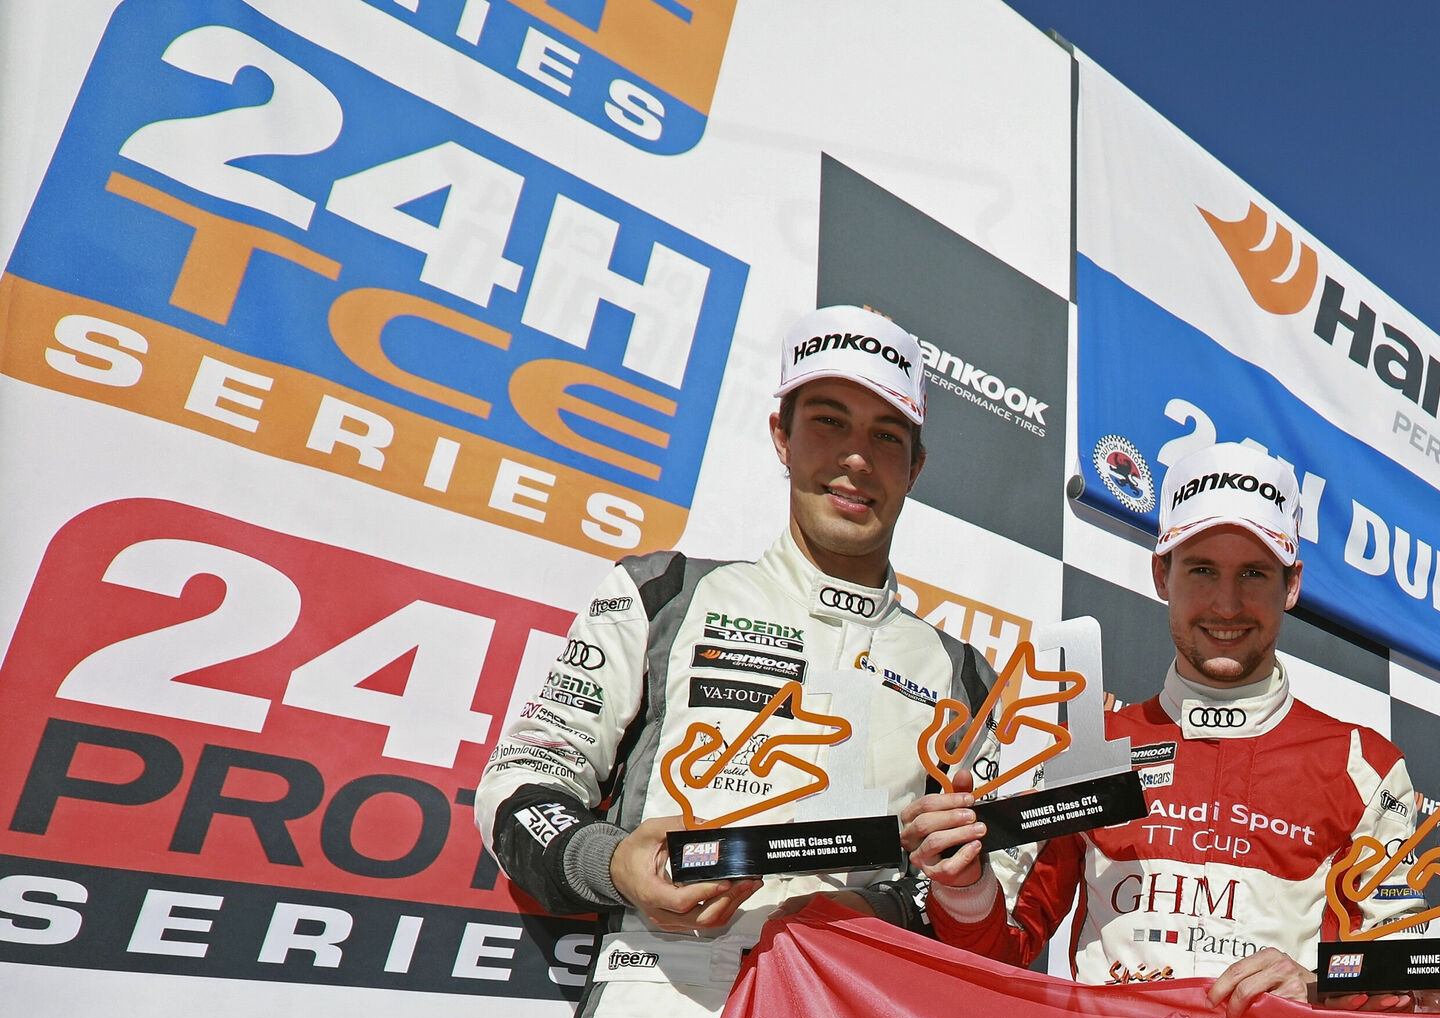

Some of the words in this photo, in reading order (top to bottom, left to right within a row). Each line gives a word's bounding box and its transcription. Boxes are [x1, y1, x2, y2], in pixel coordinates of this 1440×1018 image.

[118, 25, 711, 390] 24H
[105, 171, 678, 482] TCE
[44, 314, 645, 550] SERIES
[1014, 417, 1046, 438] TIRES
[1157, 398, 1326, 545] 2H
[732, 660, 762, 670] driving
[763, 665, 799, 677] emotion
[545, 671, 604, 701] HOENIX
[700, 684, 784, 708] 'VA-TOUT
[883, 669, 938, 700] DUBAI
[8, 717, 510, 891] PROT
[1020, 804, 1056, 820] WINNER
[1056, 800, 1080, 812] Class
[1081, 795, 1098, 807] GT4
[1021, 816, 1052, 830] HANKOOK
[1052, 814, 1066, 824] 24H
[1066, 810, 1086, 821] DUBAI
[1086, 805, 1103, 816] 2018
[1148, 800, 1220, 823] Audi
[1230, 803, 1316, 846] Sport
[684, 842, 717, 856] 24H
[767, 849, 801, 860] HANKOOK
[802, 848, 816, 857] 24H
[817, 847, 839, 857] DUBAI
[839, 845, 857, 854] 2018
[768, 838, 807, 850] WINNER
[808, 836, 833, 847] Class
[835, 834, 853, 845] GT4
[1142, 825, 1182, 845] TT
[1193, 829, 1251, 859] Cup
[1111, 873, 1241, 921] GHM
[1380, 887, 1425, 896] RAVEN
[0, 874, 596, 985] SERIES
[1186, 926, 1271, 958] Partn
[609, 950, 659, 968] freem
[1331, 955, 1362, 967] 24H
[1407, 966, 1440, 975] HANKOOK
